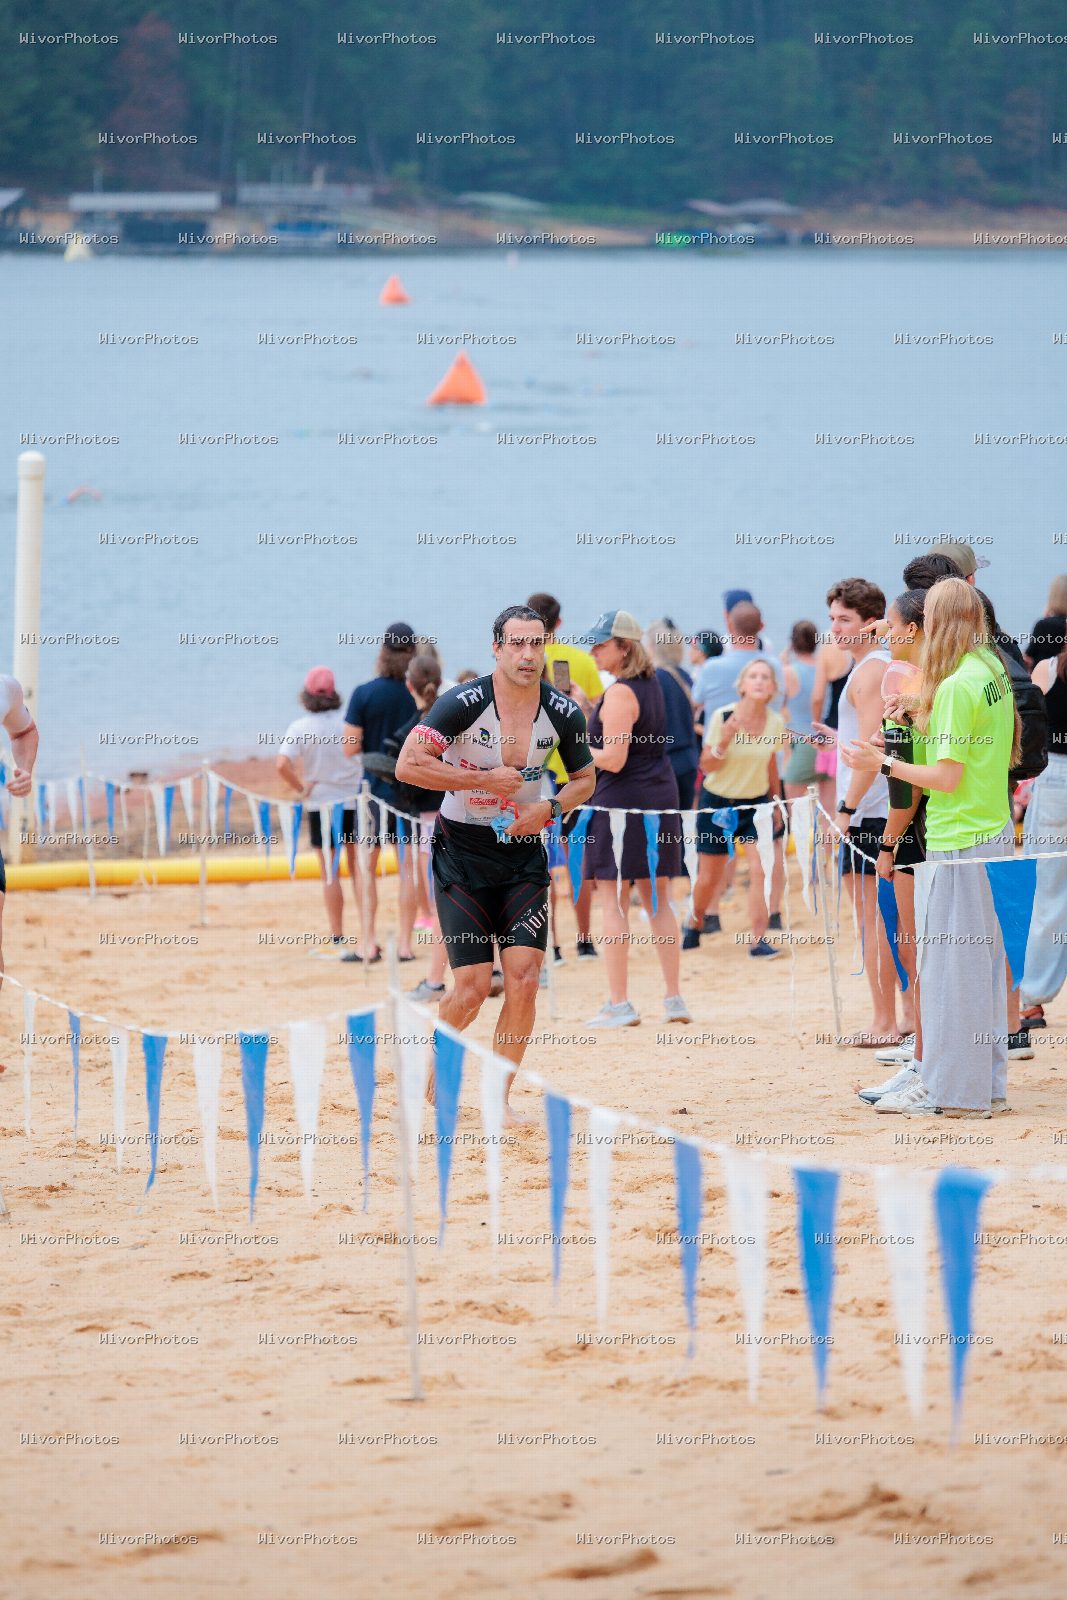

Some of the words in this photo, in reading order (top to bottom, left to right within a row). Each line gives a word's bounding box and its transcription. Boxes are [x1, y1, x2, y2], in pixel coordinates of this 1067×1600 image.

[456, 685, 485, 707] TRY
[548, 691, 579, 718] TRY
[537, 737, 553, 747] TRY
